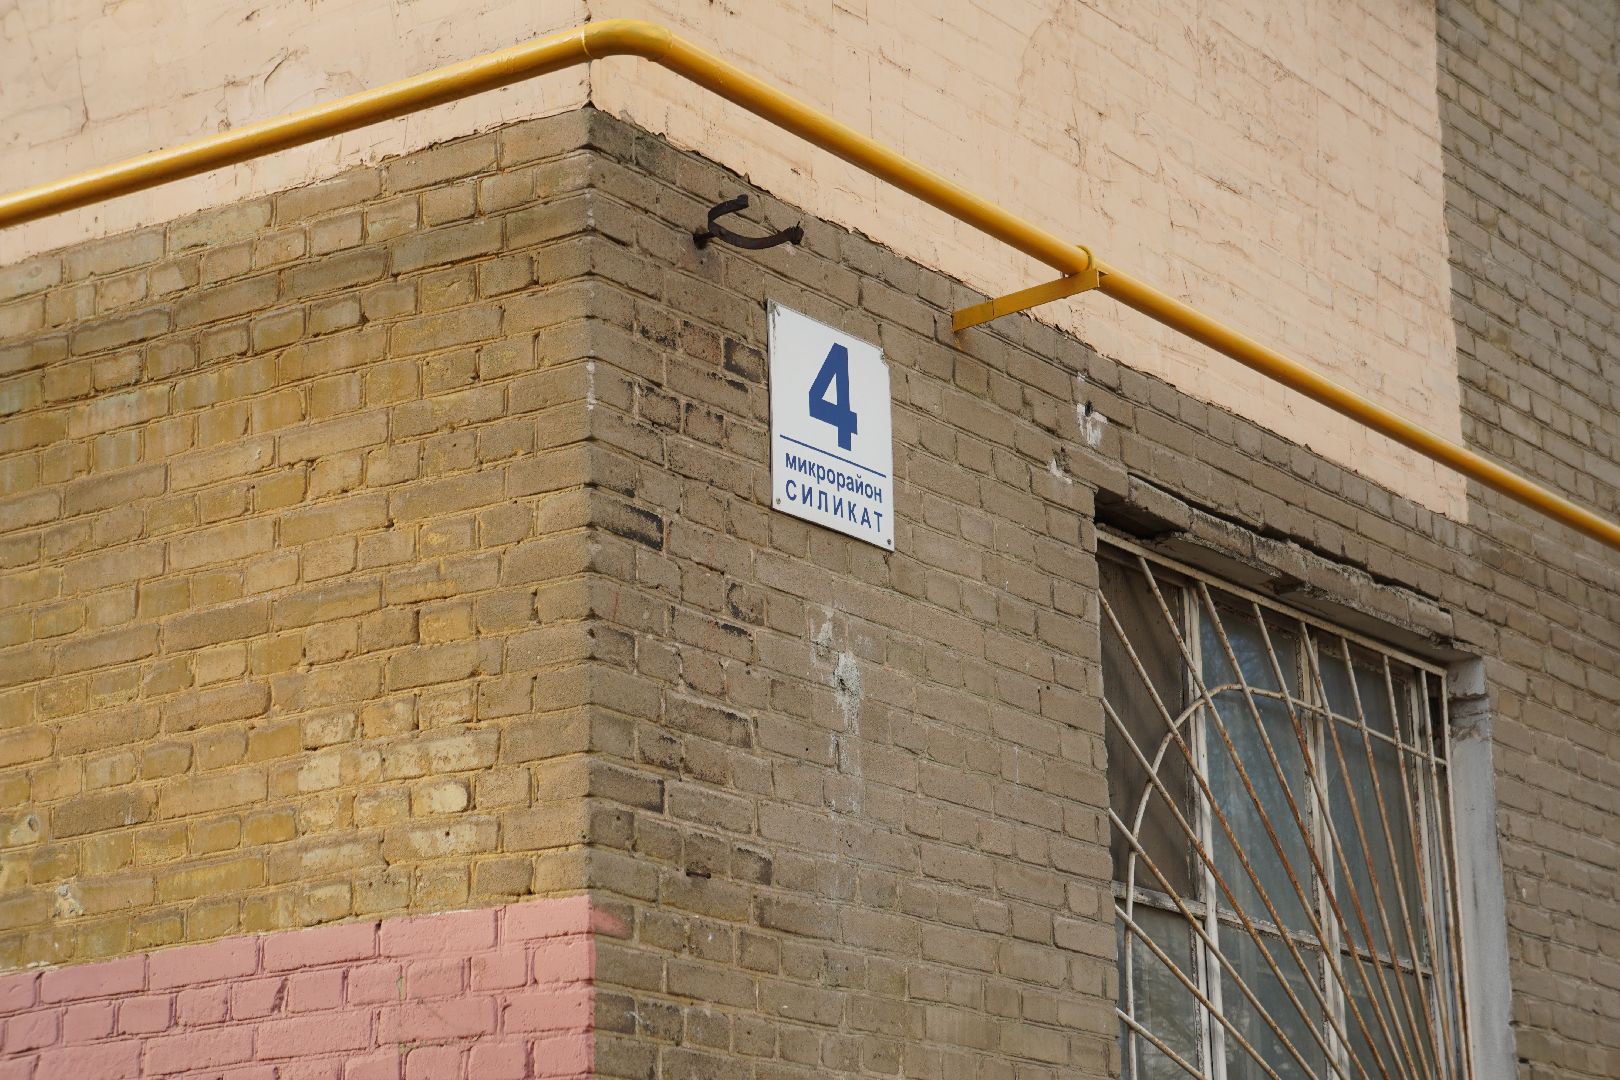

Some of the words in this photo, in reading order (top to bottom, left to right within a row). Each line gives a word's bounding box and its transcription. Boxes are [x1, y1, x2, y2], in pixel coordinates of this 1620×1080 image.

[808, 342, 858, 451] 4
[785, 452, 883, 503] микрорайон
[785, 479, 883, 532] СИЛИКАТ
